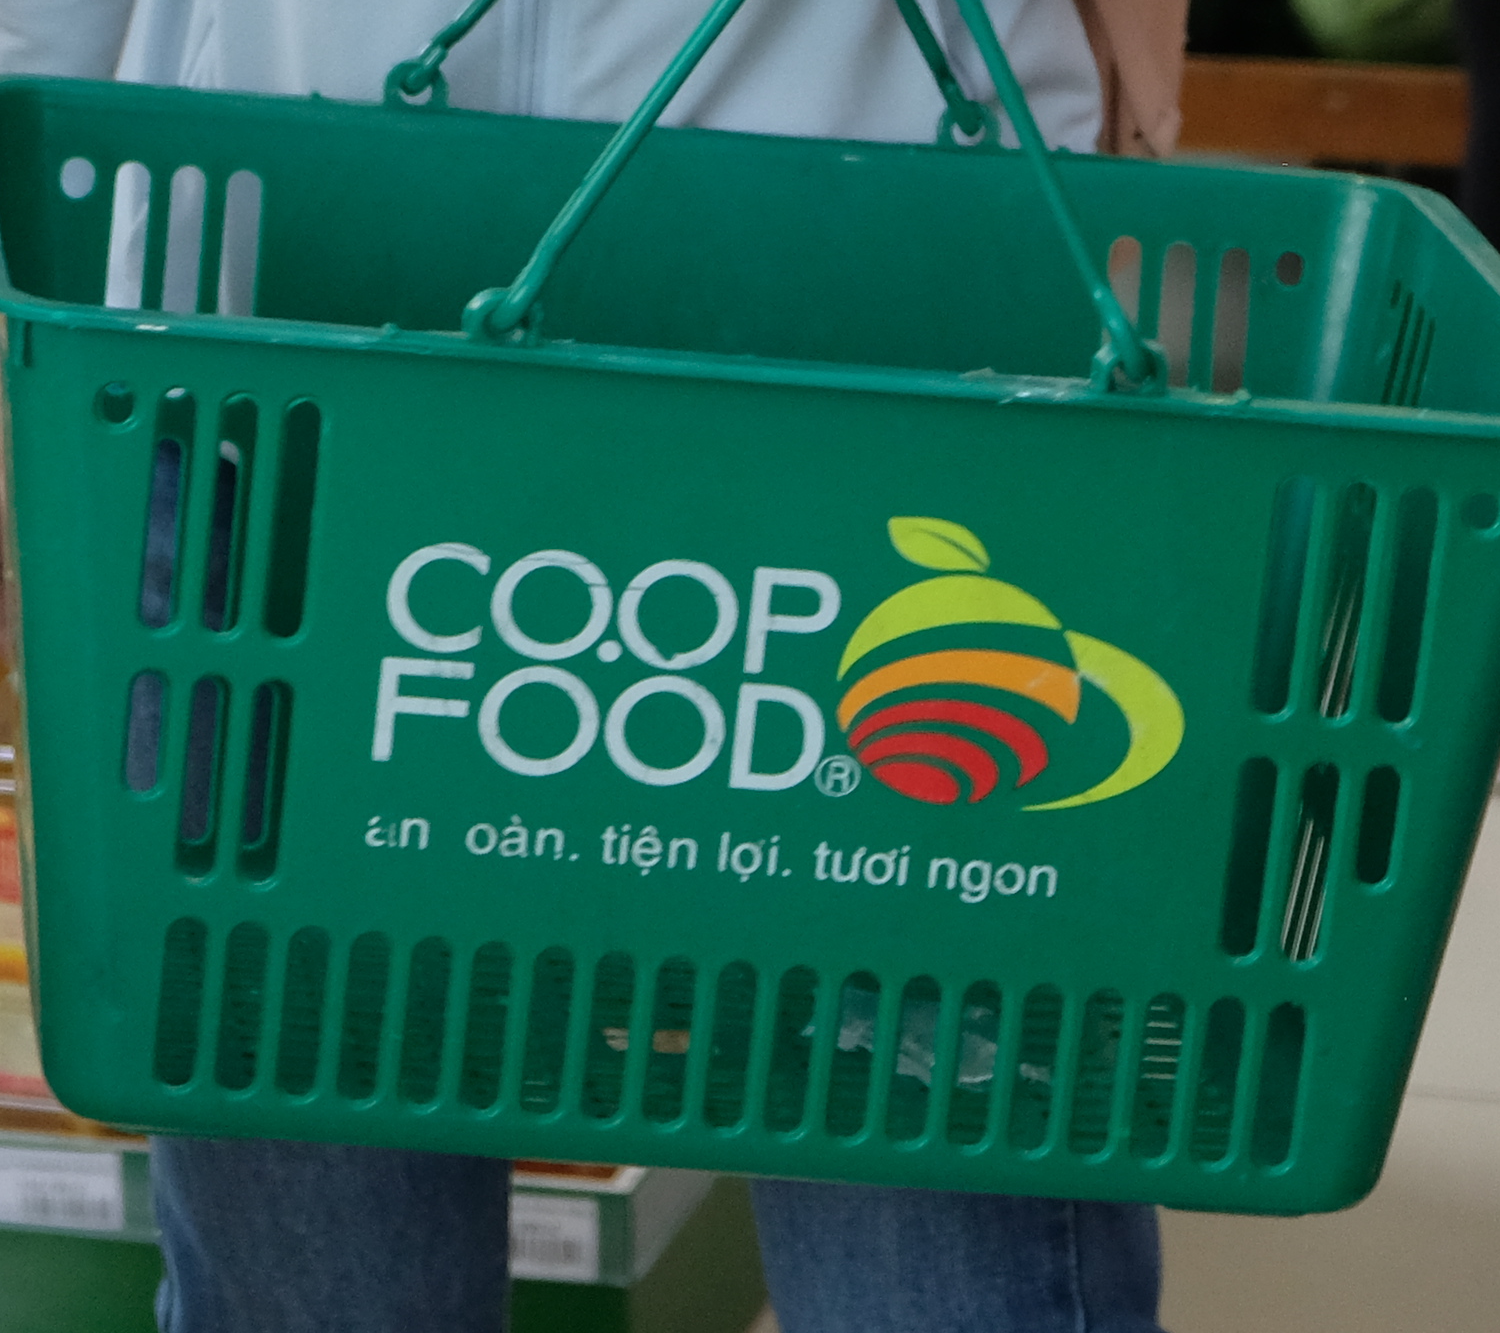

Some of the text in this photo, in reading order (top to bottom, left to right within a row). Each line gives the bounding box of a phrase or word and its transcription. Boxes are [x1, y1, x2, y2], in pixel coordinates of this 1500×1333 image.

[386, 543, 841, 674] CO.OP
[601, 822, 699, 880] tiện
[813, 839, 910, 888] tươi
[927, 854, 1060, 904] ngon
